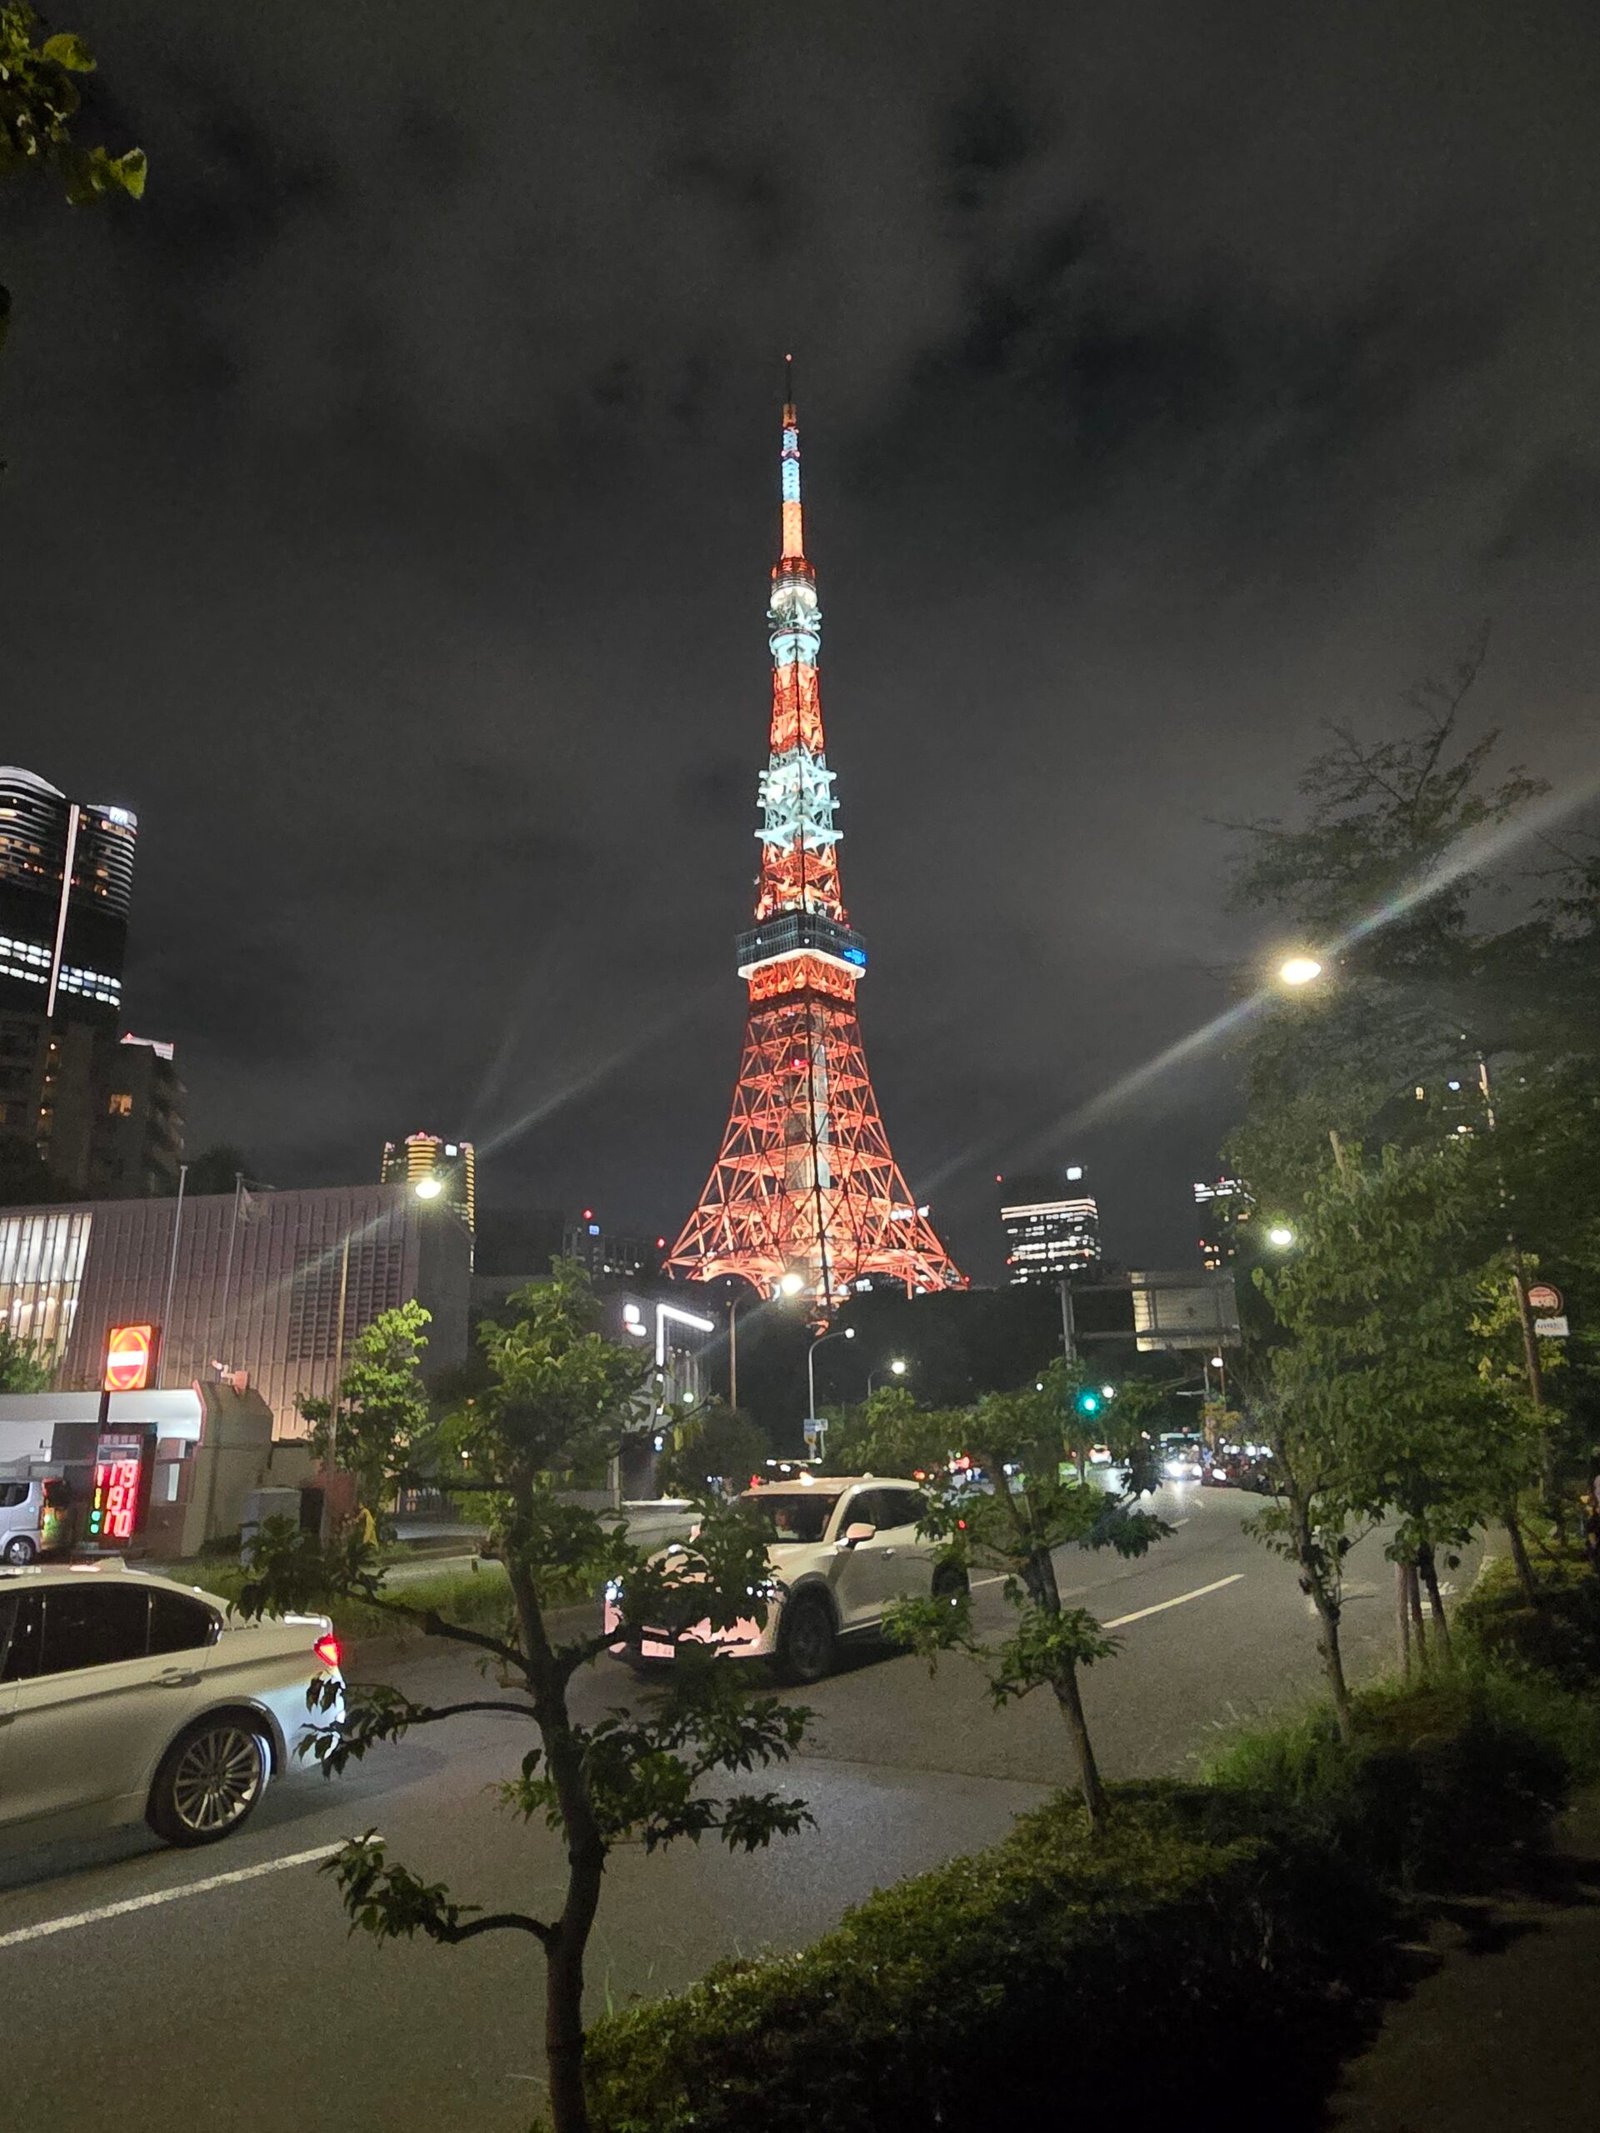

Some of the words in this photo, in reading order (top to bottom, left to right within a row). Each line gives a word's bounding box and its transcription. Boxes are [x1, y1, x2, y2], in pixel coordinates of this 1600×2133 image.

[109, 1461, 137, 1488] 179
[106, 1487, 135, 1511] 191
[103, 1510, 132, 1536] 170
